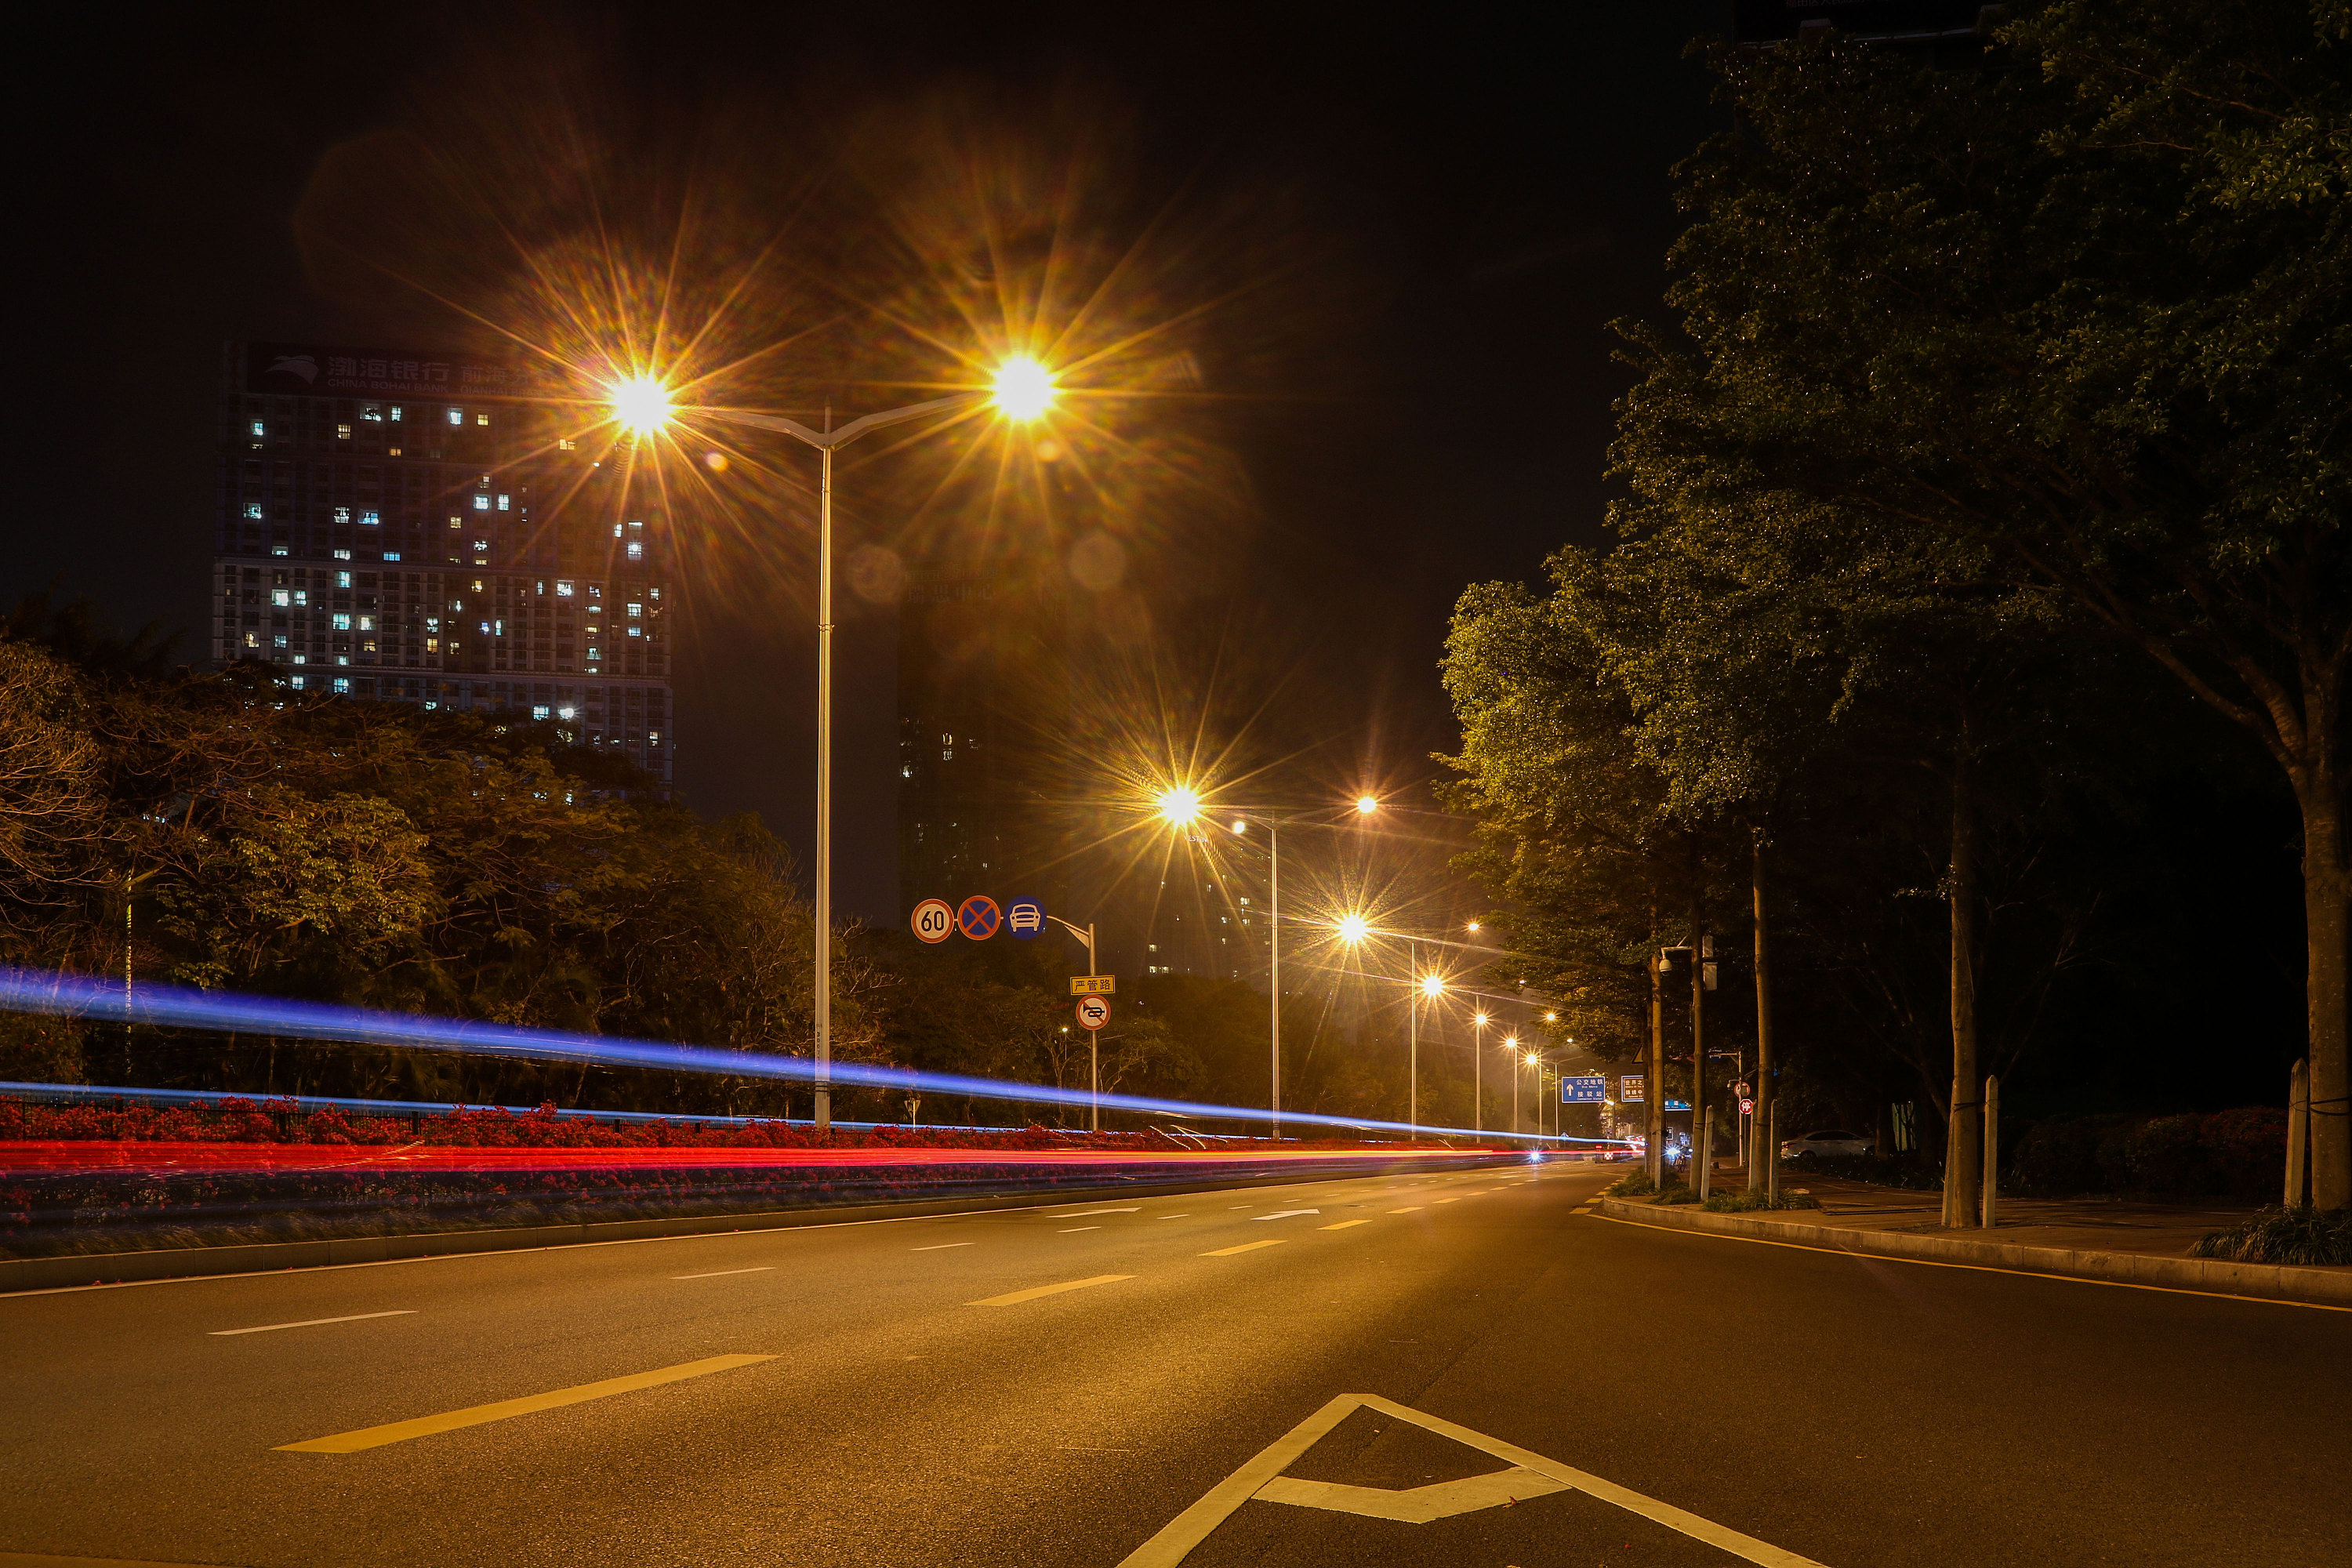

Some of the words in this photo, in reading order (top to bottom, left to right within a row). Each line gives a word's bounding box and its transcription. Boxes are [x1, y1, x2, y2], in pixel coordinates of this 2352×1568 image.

[328, 357, 450, 381] 渤海银行
[327, 378, 367, 389] CHINA
[370, 380, 410, 391] BOHAI
[414, 383, 449, 394] BANK
[921, 910, 944, 931] 60
[1075, 979, 1110, 992] 严管路
[1741, 1102, 1751, 1111] 停
